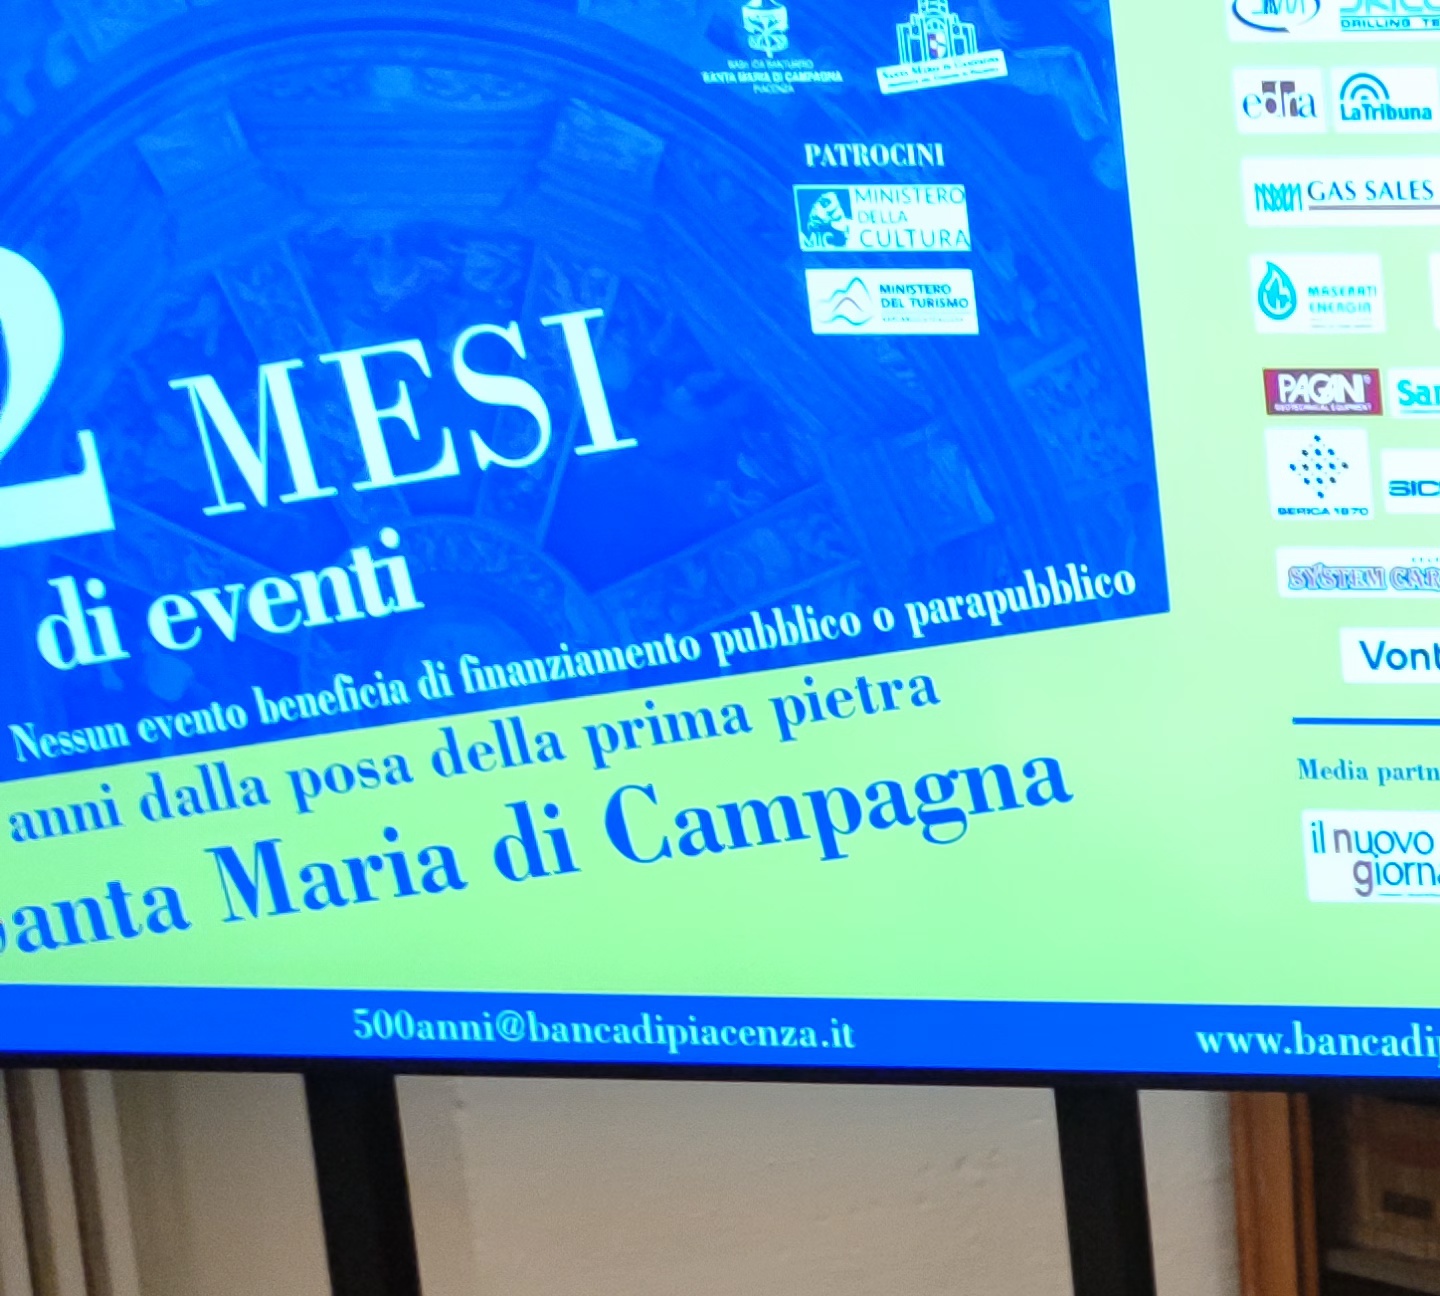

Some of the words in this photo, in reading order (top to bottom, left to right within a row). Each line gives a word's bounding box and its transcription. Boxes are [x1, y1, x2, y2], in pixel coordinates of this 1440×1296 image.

[805, 142, 945, 168] PATROCINI
[855, 187, 966, 205] MINISTERO
[1307, 181, 1356, 202] GAS
[1366, 179, 1433, 201] SALES
[858, 210, 908, 224] DELLA
[860, 229, 971, 248] CULTURA
[879, 283, 952, 295] MINISTERO
[881, 297, 904, 309] DEL
[911, 297, 969, 309] TURISMO
[168, 307, 638, 516] MESI
[36, 574, 131, 672] di
[147, 527, 426, 653] eventi
[8, 721, 131, 767] Nessun
[137, 693, 248, 744] evento
[252, 671, 410, 730] beneficia
[418, 660, 453, 701] di
[460, 630, 702, 697] finanziamento
[711, 603, 862, 677] pubblico
[873, 606, 895, 632] o
[904, 562, 1137, 638] parapubblico
[8, 782, 127, 845] anni
[139, 760, 271, 825] dalla
[284, 753, 415, 815] posa
[430, 714, 566, 779] della
[583, 699, 753, 771] prima
[768, 672, 941, 745] pietra
[1297, 757, 1370, 782] Media
[1310, 820, 1327, 854] il
[1333, 827, 1435, 858] nuovo
[0, 878, 192, 956] anta
[204, 826, 468, 924] Maria
[492, 801, 581, 883] di
[604, 756, 1075, 863] Campagna
[351, 1007, 857, 1055] 500anni@bancadipiacenza.it
